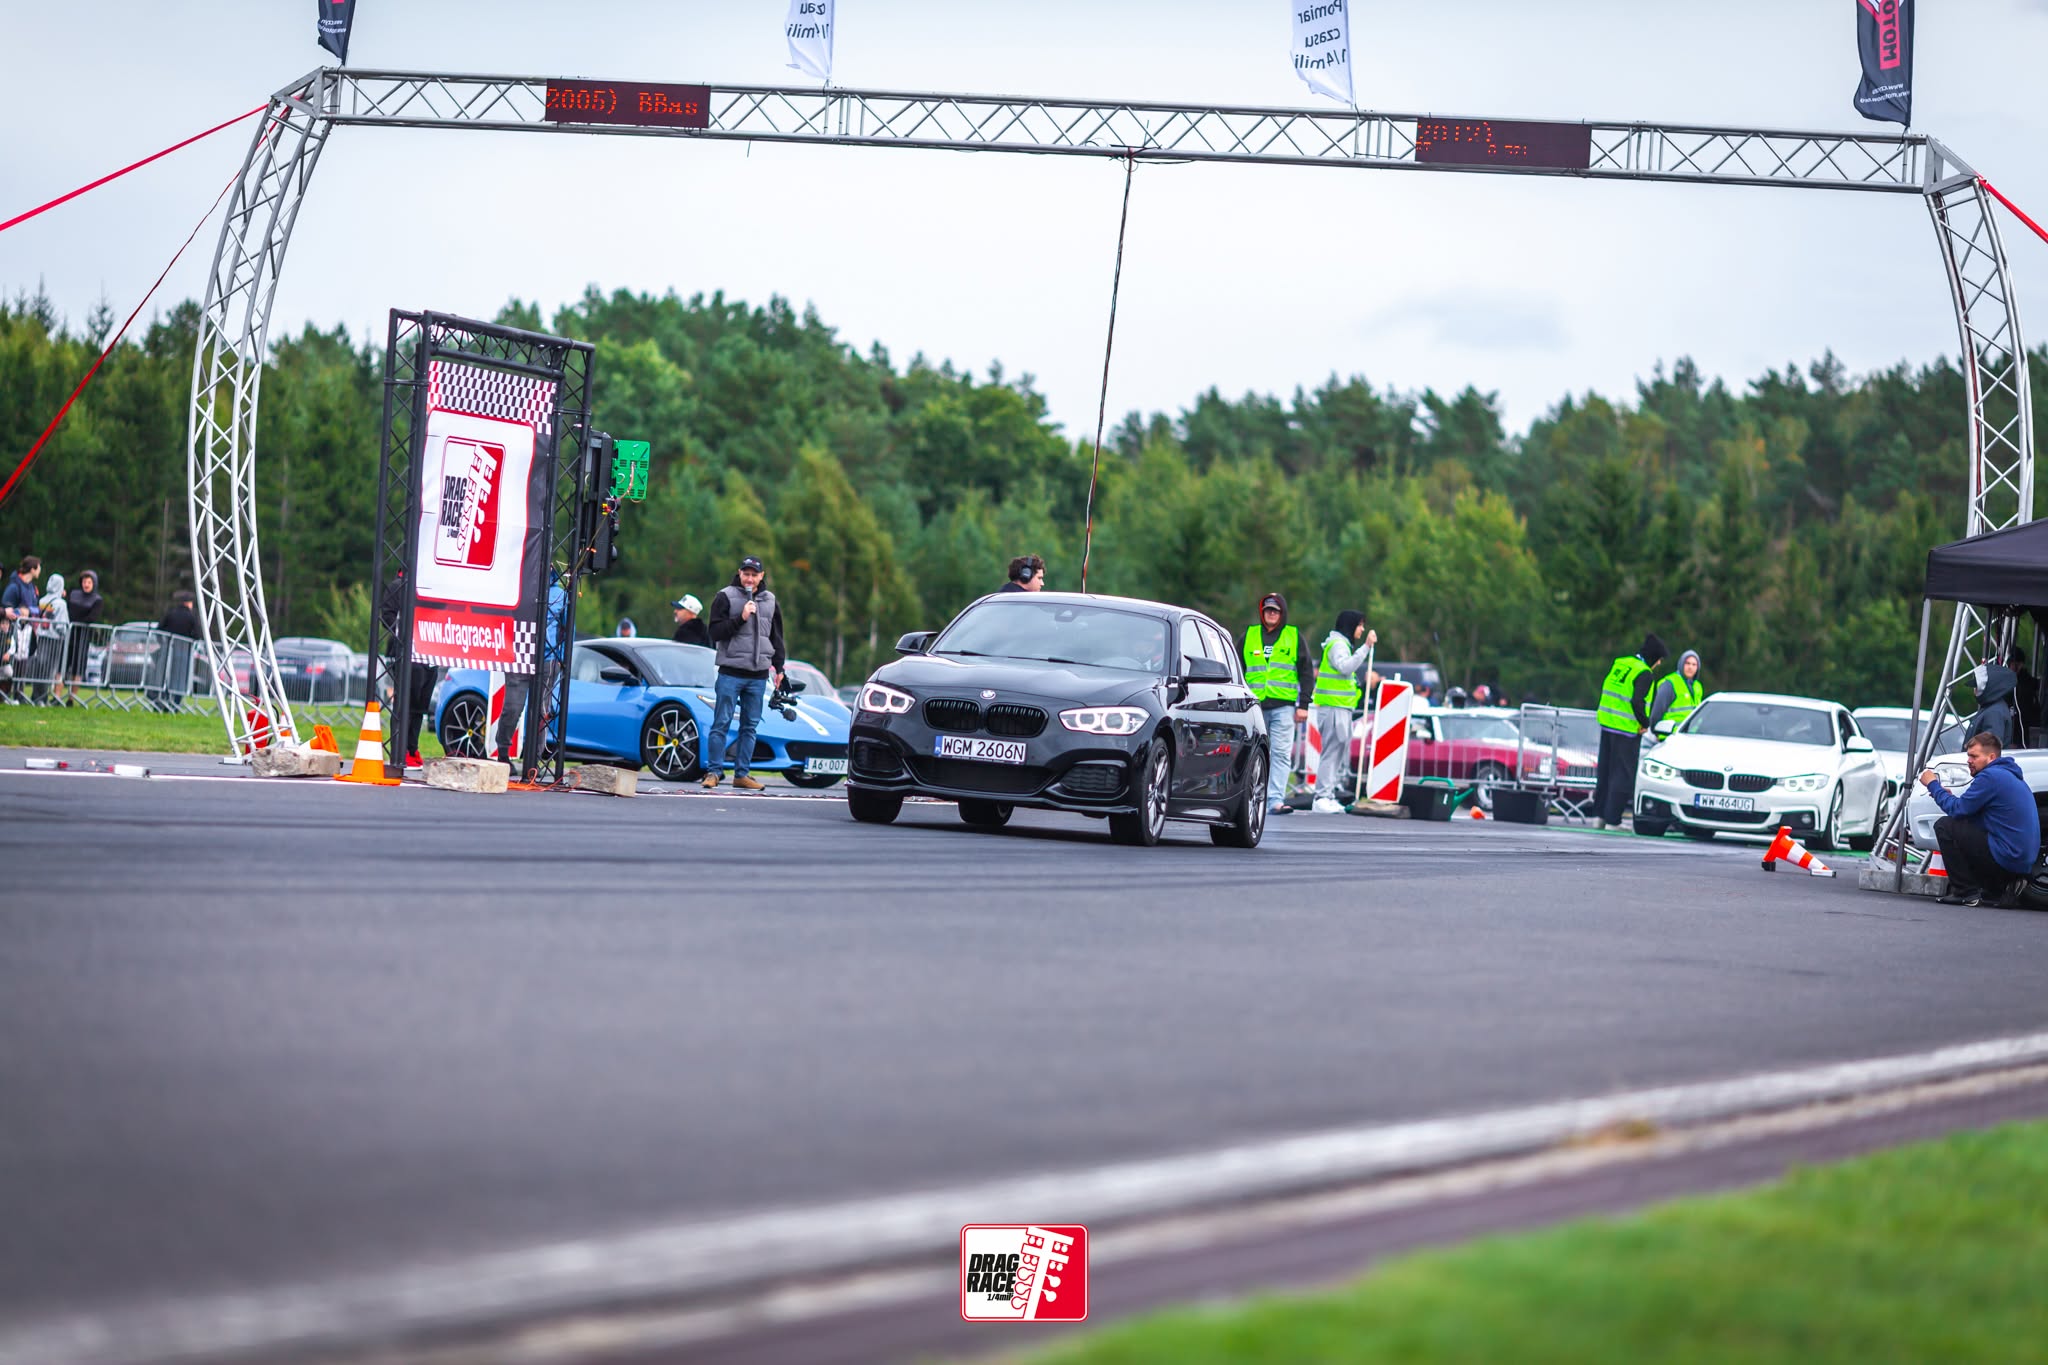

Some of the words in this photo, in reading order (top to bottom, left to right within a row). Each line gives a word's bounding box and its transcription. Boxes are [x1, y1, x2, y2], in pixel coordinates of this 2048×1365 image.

[546, 88, 617, 115] 2005)
[443, 475, 467, 501] DRAG
[440, 500, 463, 527] RACE
[418, 617, 506, 656] www.dragrace.pl
[943, 738, 973, 755] WGM
[977, 741, 1024, 760] 2606N
[828, 760, 845, 770] 007
